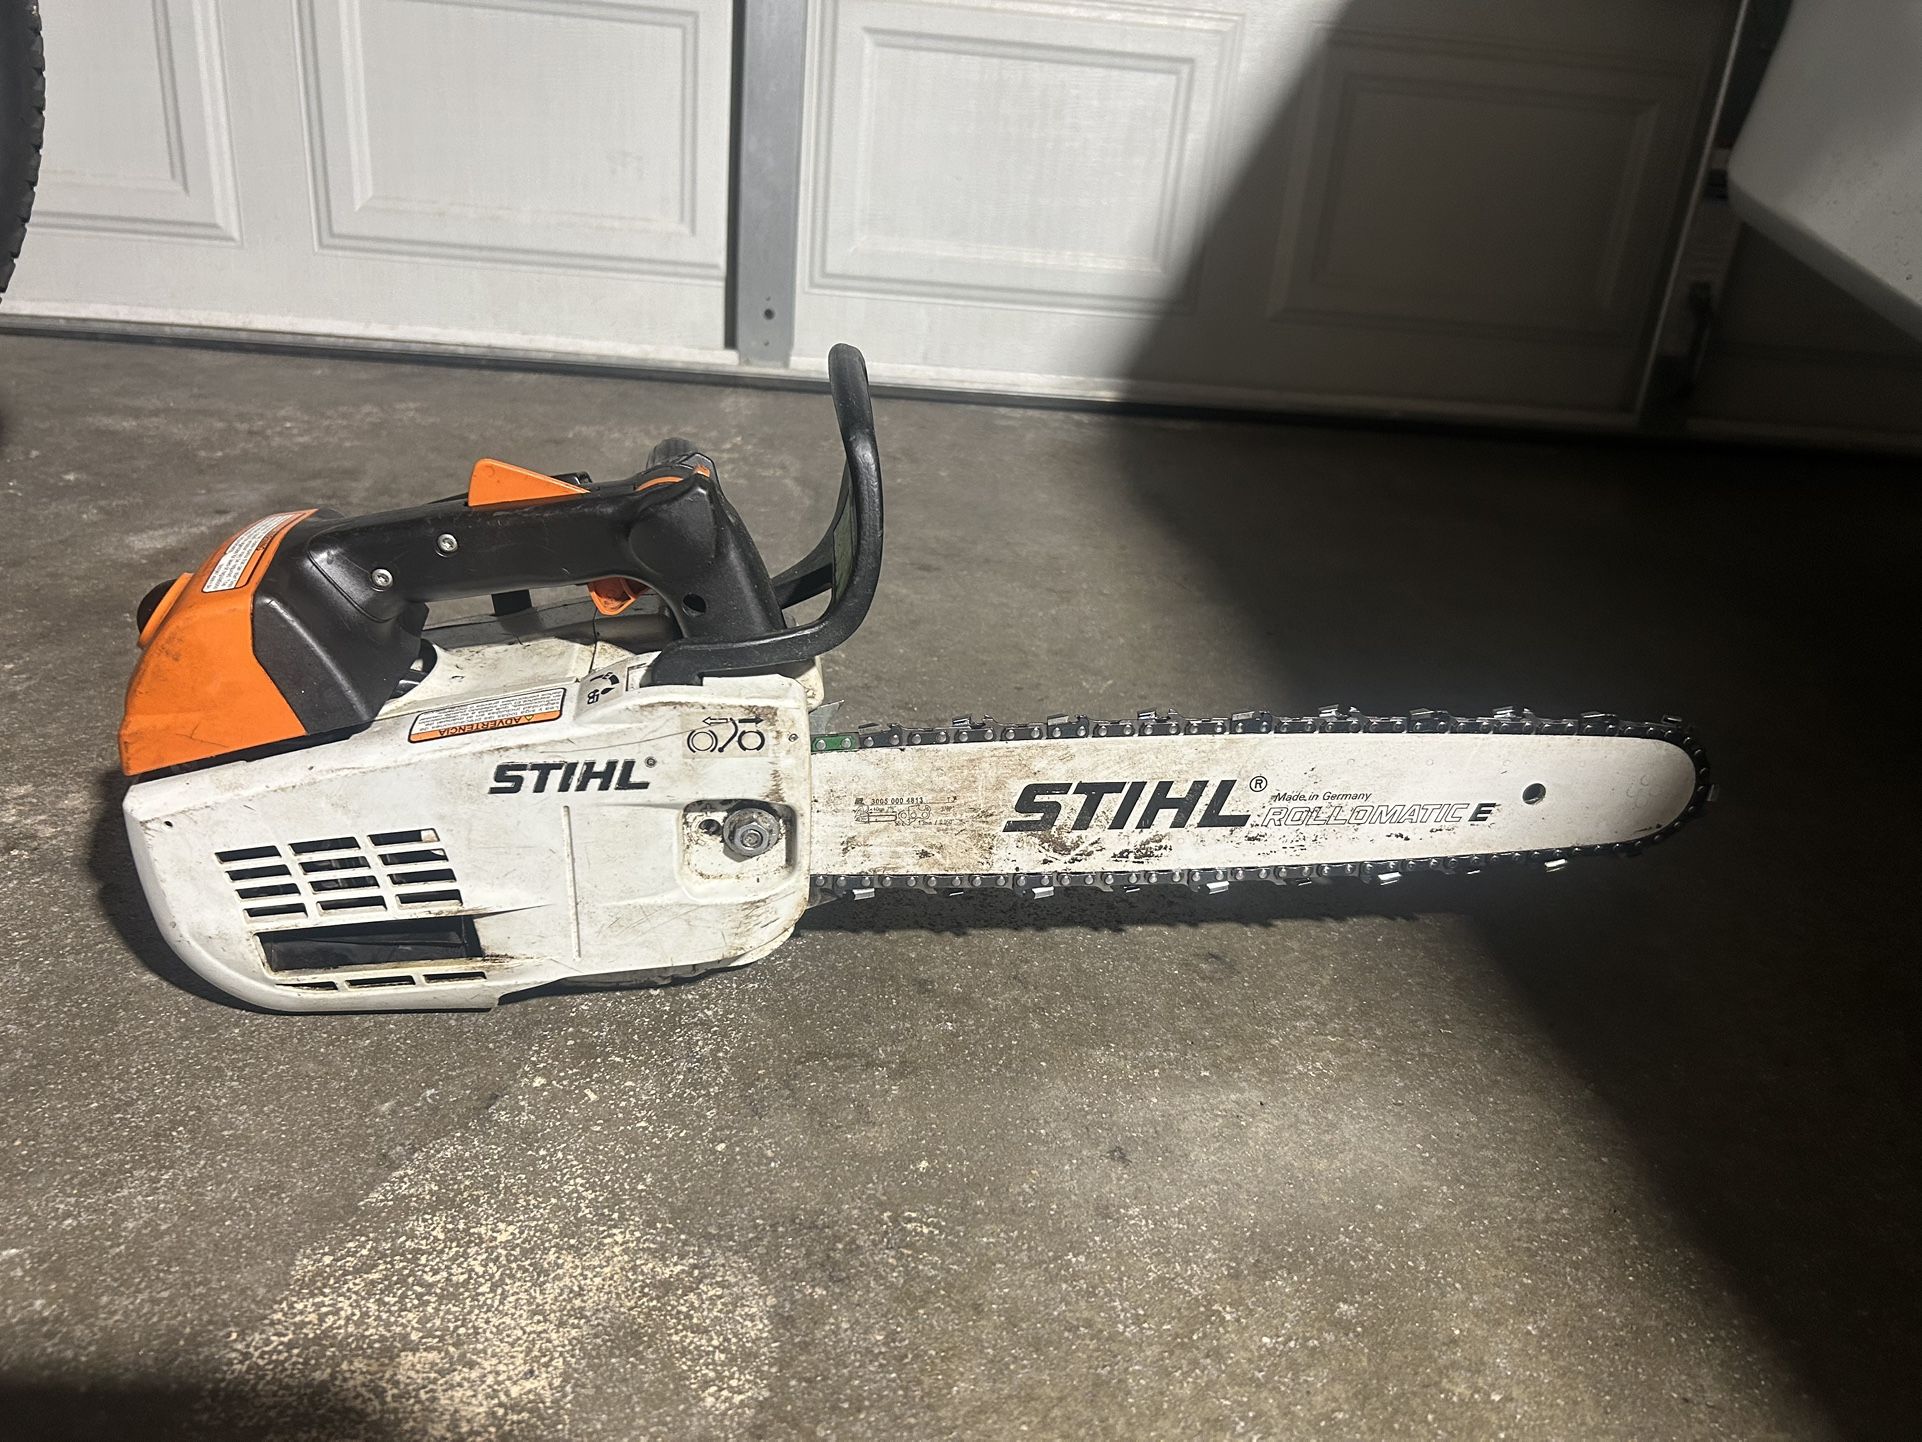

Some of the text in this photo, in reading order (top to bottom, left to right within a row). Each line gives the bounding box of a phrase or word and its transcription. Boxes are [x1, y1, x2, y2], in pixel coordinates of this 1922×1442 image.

[439, 718, 521, 735] ADVERTENCIA
[1274, 791, 1372, 802] Made in Germany
[1261, 802, 1496, 826] ROLLOMATIC E
